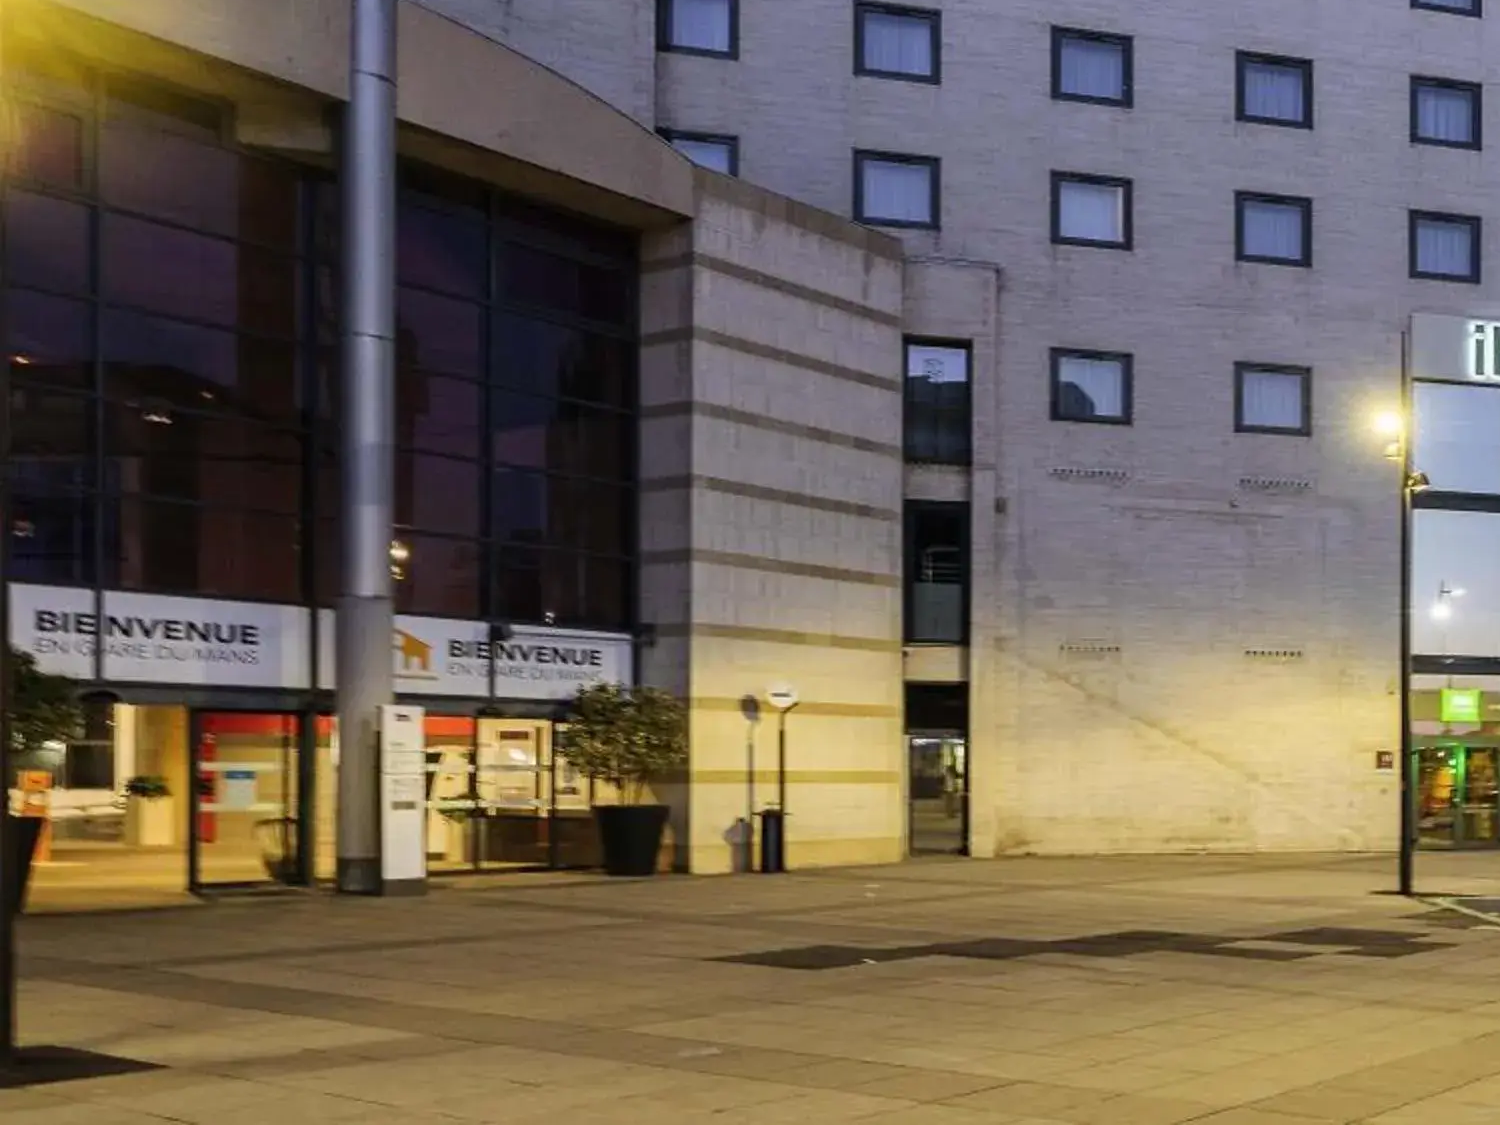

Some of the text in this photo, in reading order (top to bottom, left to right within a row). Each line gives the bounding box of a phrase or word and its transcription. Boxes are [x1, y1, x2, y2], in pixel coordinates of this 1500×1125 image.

[35, 610, 260, 645] BIENVENUE
[34, 638, 69, 654] EN
[448, 639, 602, 666] BIENVENUE
